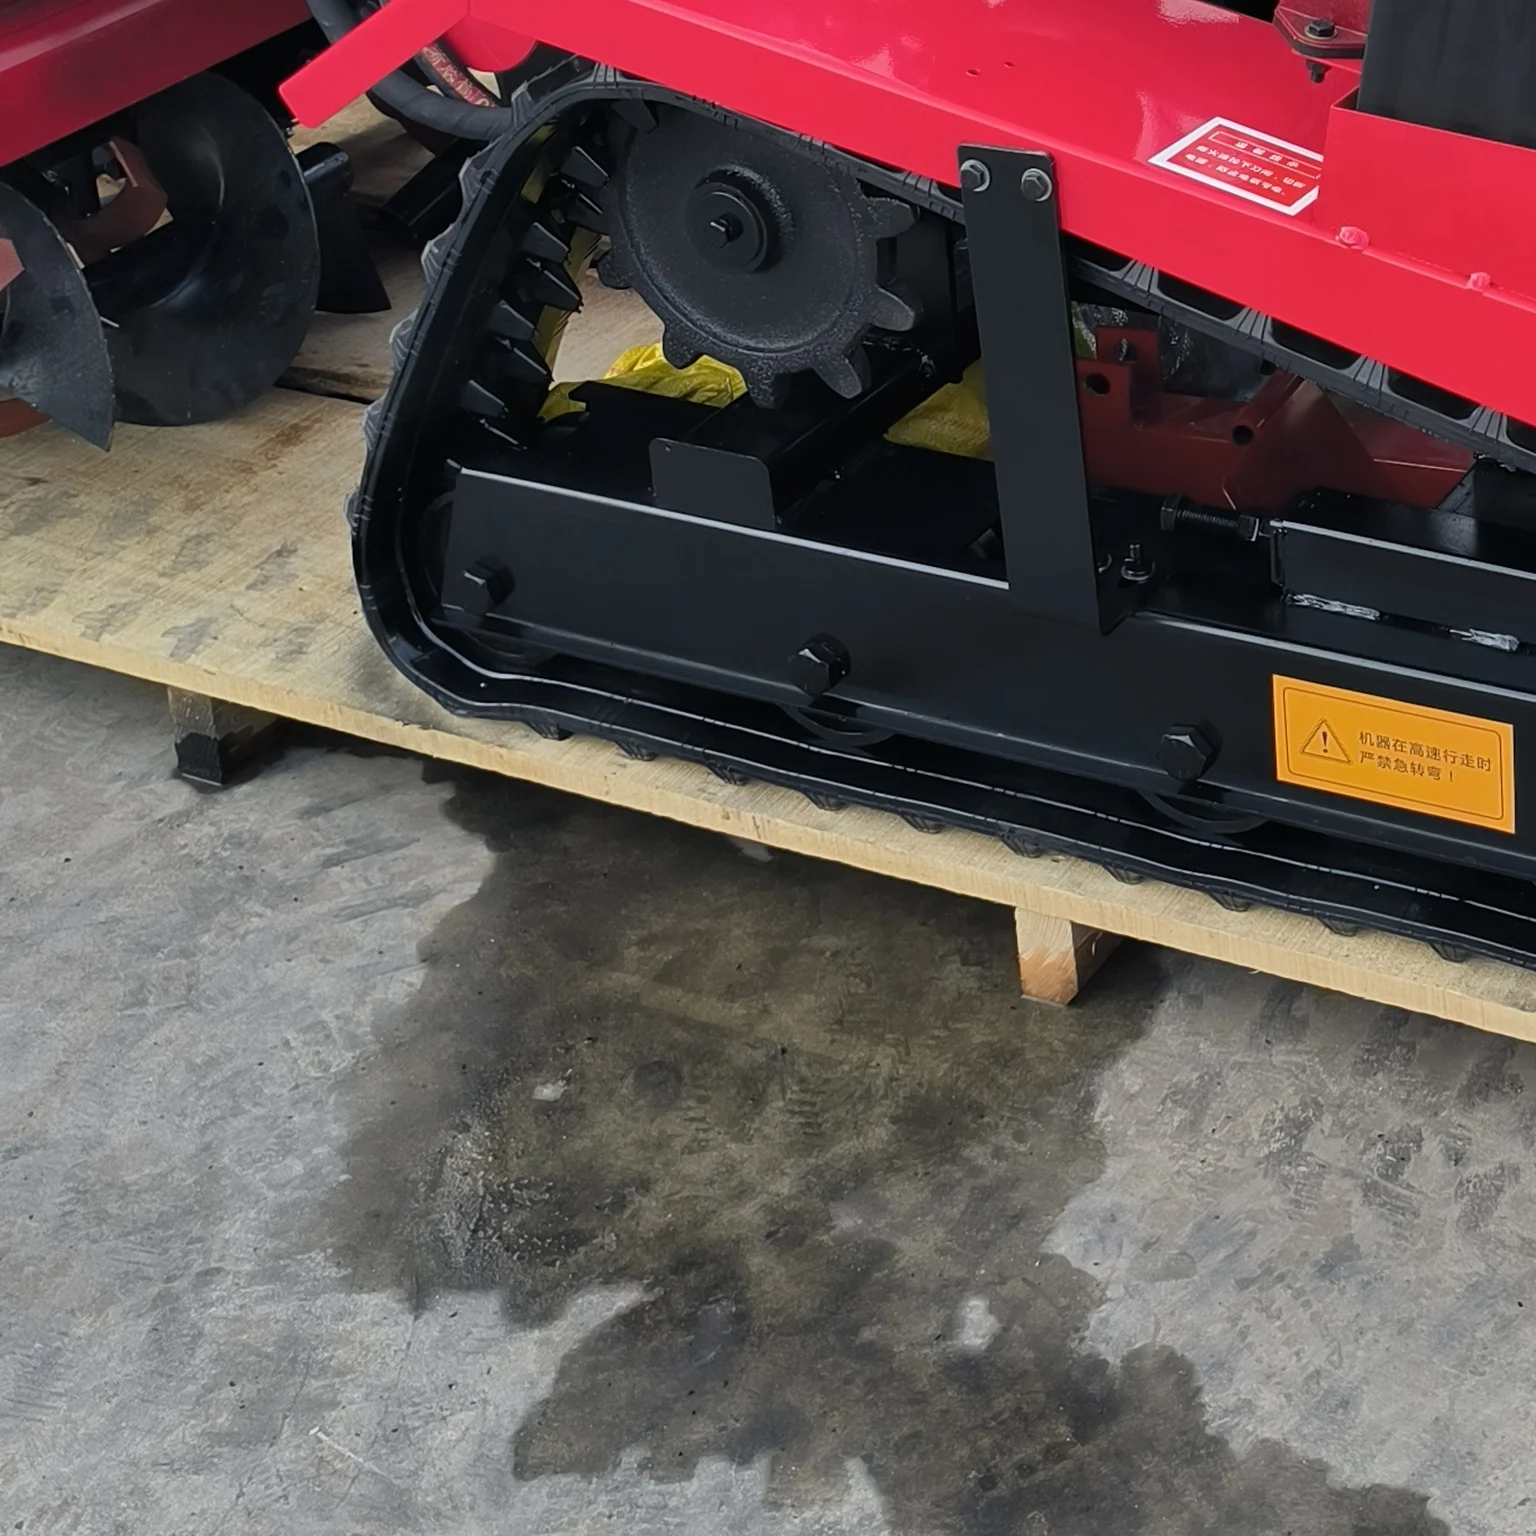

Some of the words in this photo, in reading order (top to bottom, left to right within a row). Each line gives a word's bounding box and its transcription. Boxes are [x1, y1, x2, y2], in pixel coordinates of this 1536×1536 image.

[1358, 730, 1492, 772] 机器在高速行走时
